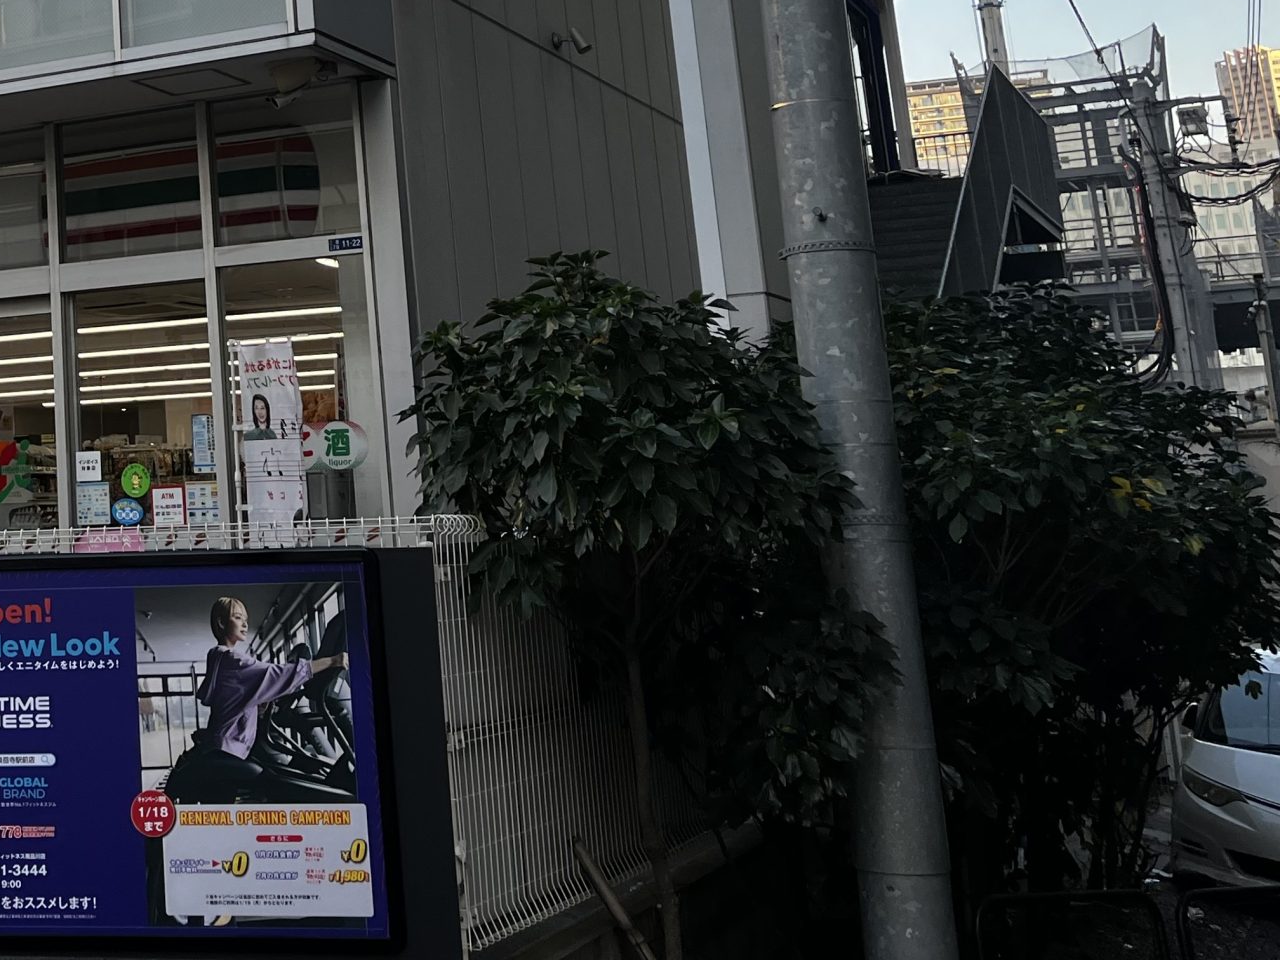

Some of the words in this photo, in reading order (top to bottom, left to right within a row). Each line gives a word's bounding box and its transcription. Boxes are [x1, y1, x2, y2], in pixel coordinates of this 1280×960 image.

[324, 428, 351, 457] 酒
[328, 458, 353, 466] liquor
[161, 492, 175, 500] ATM
[50, 631, 121, 657] Look
[3, 788, 46, 800] BRAND
[138, 806, 169, 818] 1/18
[180, 811, 234, 826] RENEWAL
[236, 810, 288, 826] OPENING
[290, 810, 351, 825] CAMPAIGN
[144, 821, 164, 832] まで
[341, 838, 368, 864] ¥0
[222, 850, 250, 877] ¥0
